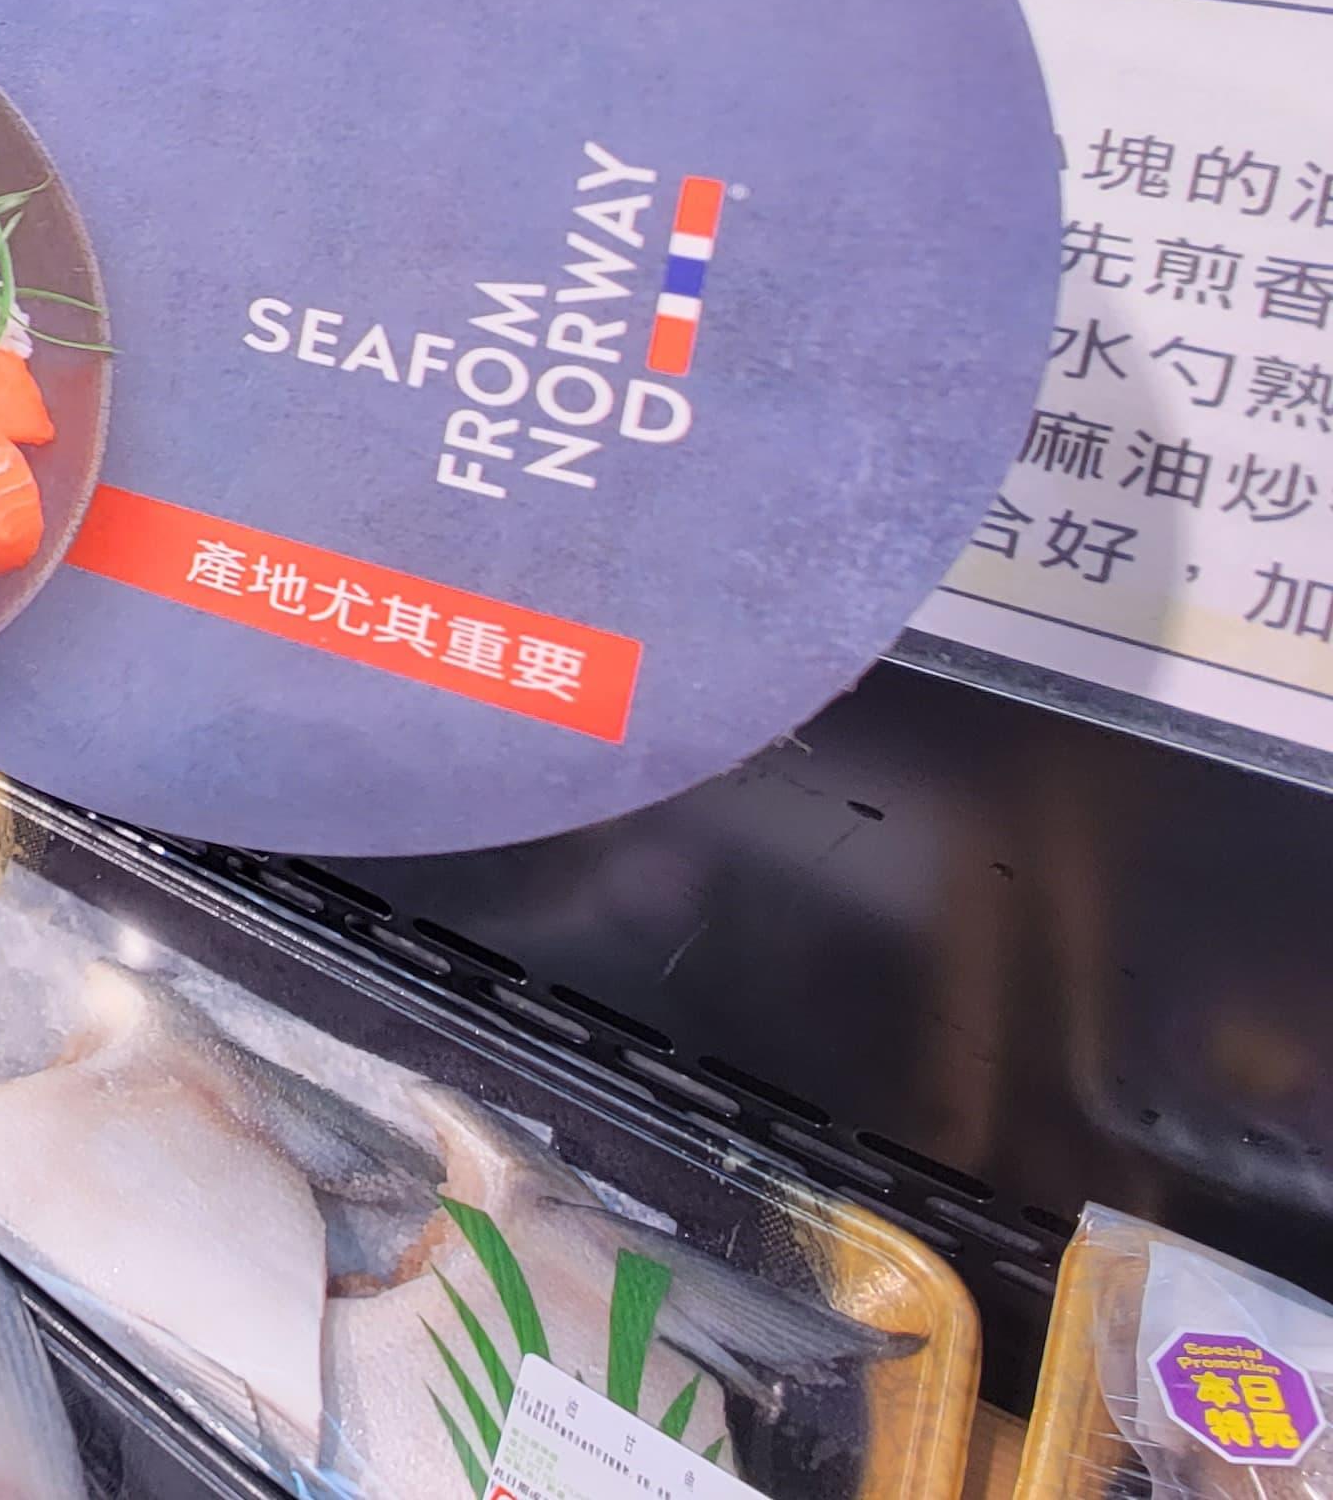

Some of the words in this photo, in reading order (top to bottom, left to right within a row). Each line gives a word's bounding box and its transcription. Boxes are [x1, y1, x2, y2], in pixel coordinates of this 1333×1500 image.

[1055, 128, 1333, 229] 塊的油
[437, 281, 547, 499] FROM
[522, 140, 658, 489] NORWAY
[1062, 219, 1333, 331] 先煎香
[1048, 318, 1333, 434] 水勺熟
[186, 538, 586, 702] 產地尤其重要
[1176, 1356, 1281, 1375] Promotion
[1184, 1342, 1263, 1360] Special
[1190, 1371, 1285, 1411] 本日
